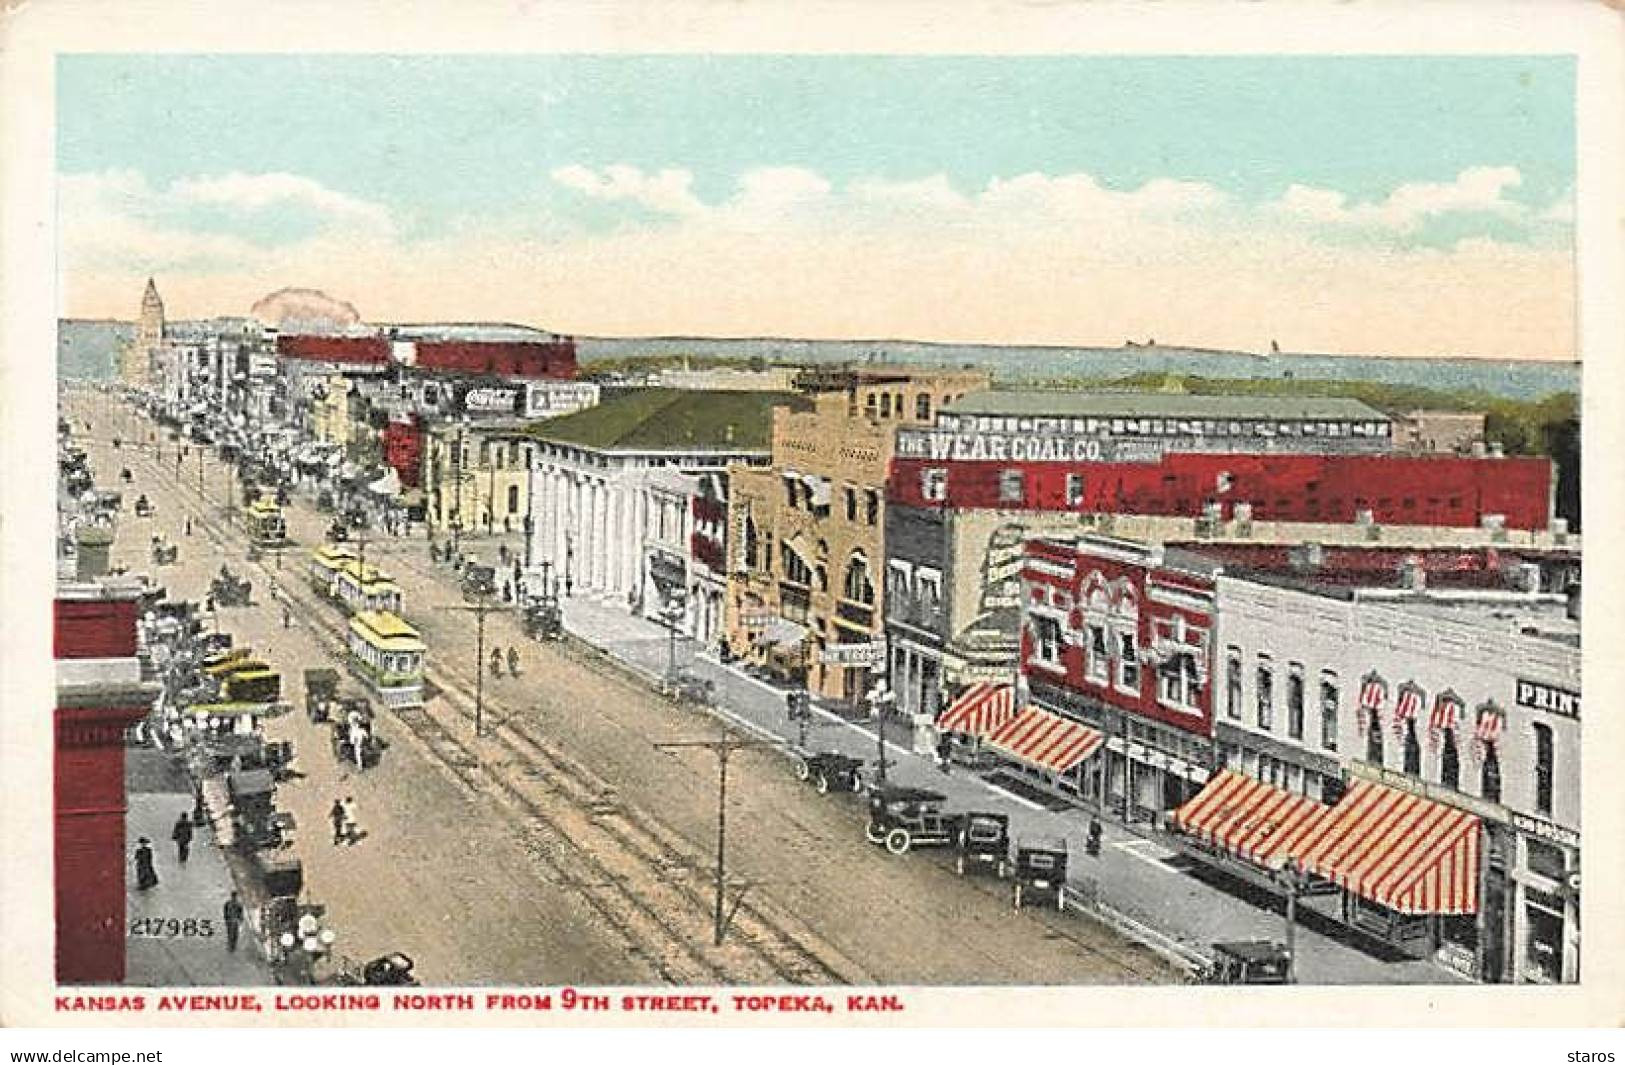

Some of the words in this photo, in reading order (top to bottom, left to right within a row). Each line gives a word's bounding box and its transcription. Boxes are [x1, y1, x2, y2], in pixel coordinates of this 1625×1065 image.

[928, 432, 1006, 460] WEAR
[1012, 435, 1071, 461] COAL
[1074, 439, 1105, 462] CO.
